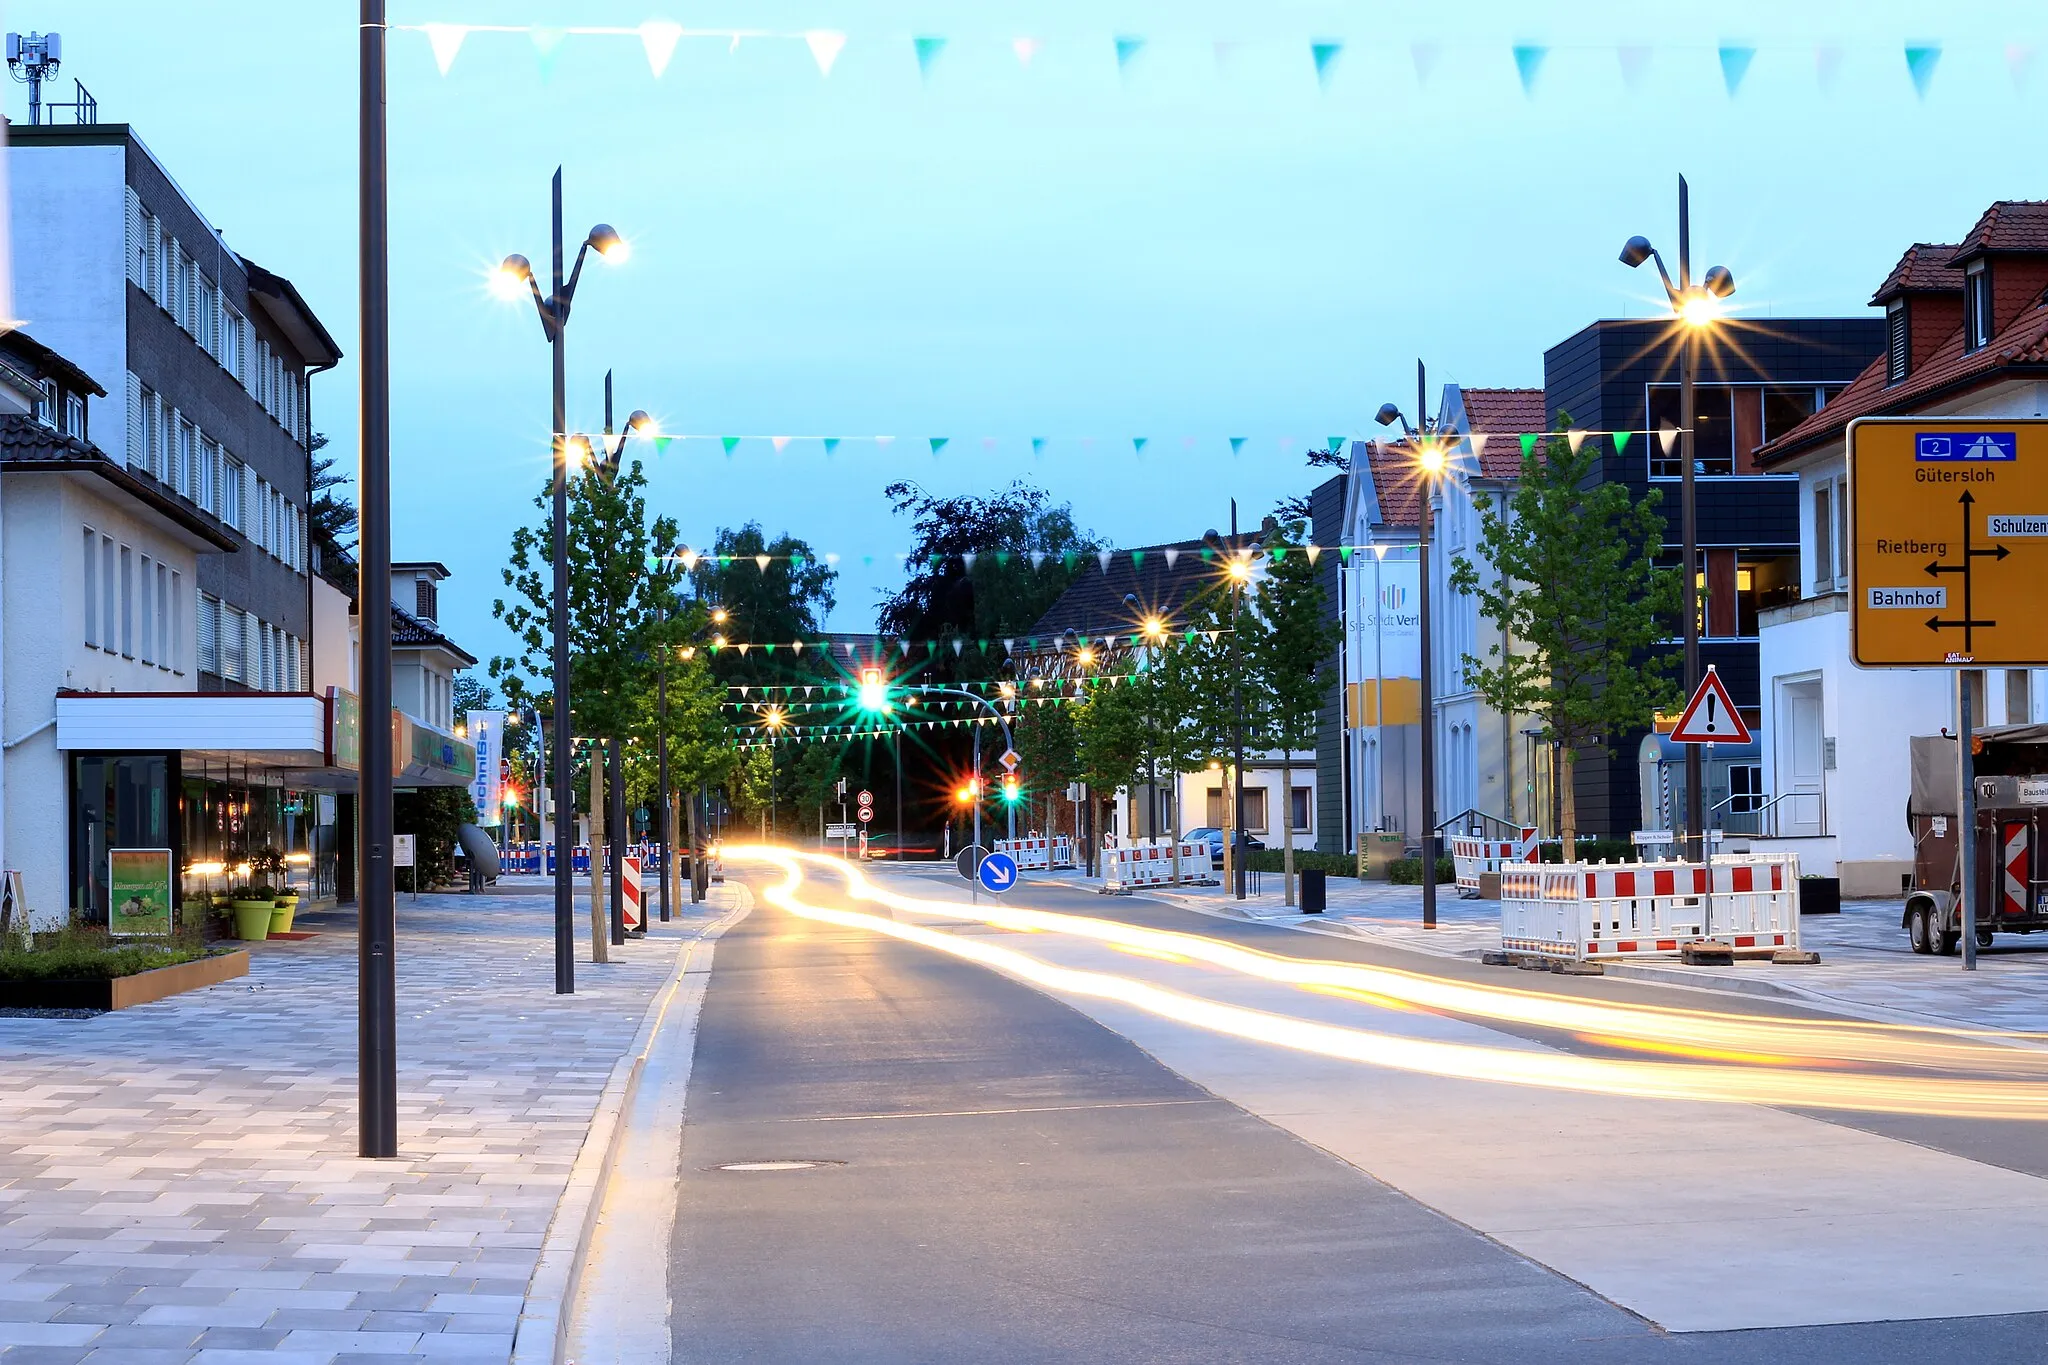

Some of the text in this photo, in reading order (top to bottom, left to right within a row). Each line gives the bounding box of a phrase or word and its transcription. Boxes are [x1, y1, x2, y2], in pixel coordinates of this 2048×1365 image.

[1932, 441, 1940, 453] 2
[1915, 467, 1995, 483] Gütersloh
[1993, 518, 2048, 534] Schulzen
[1876, 539, 1947, 557] Rietberg
[1873, 591, 1942, 606] Bahnhof
[1396, 614, 1419, 626] Verl
[1982, 783, 1997, 797] 100
[1361, 836, 1369, 877] RATHAUS
